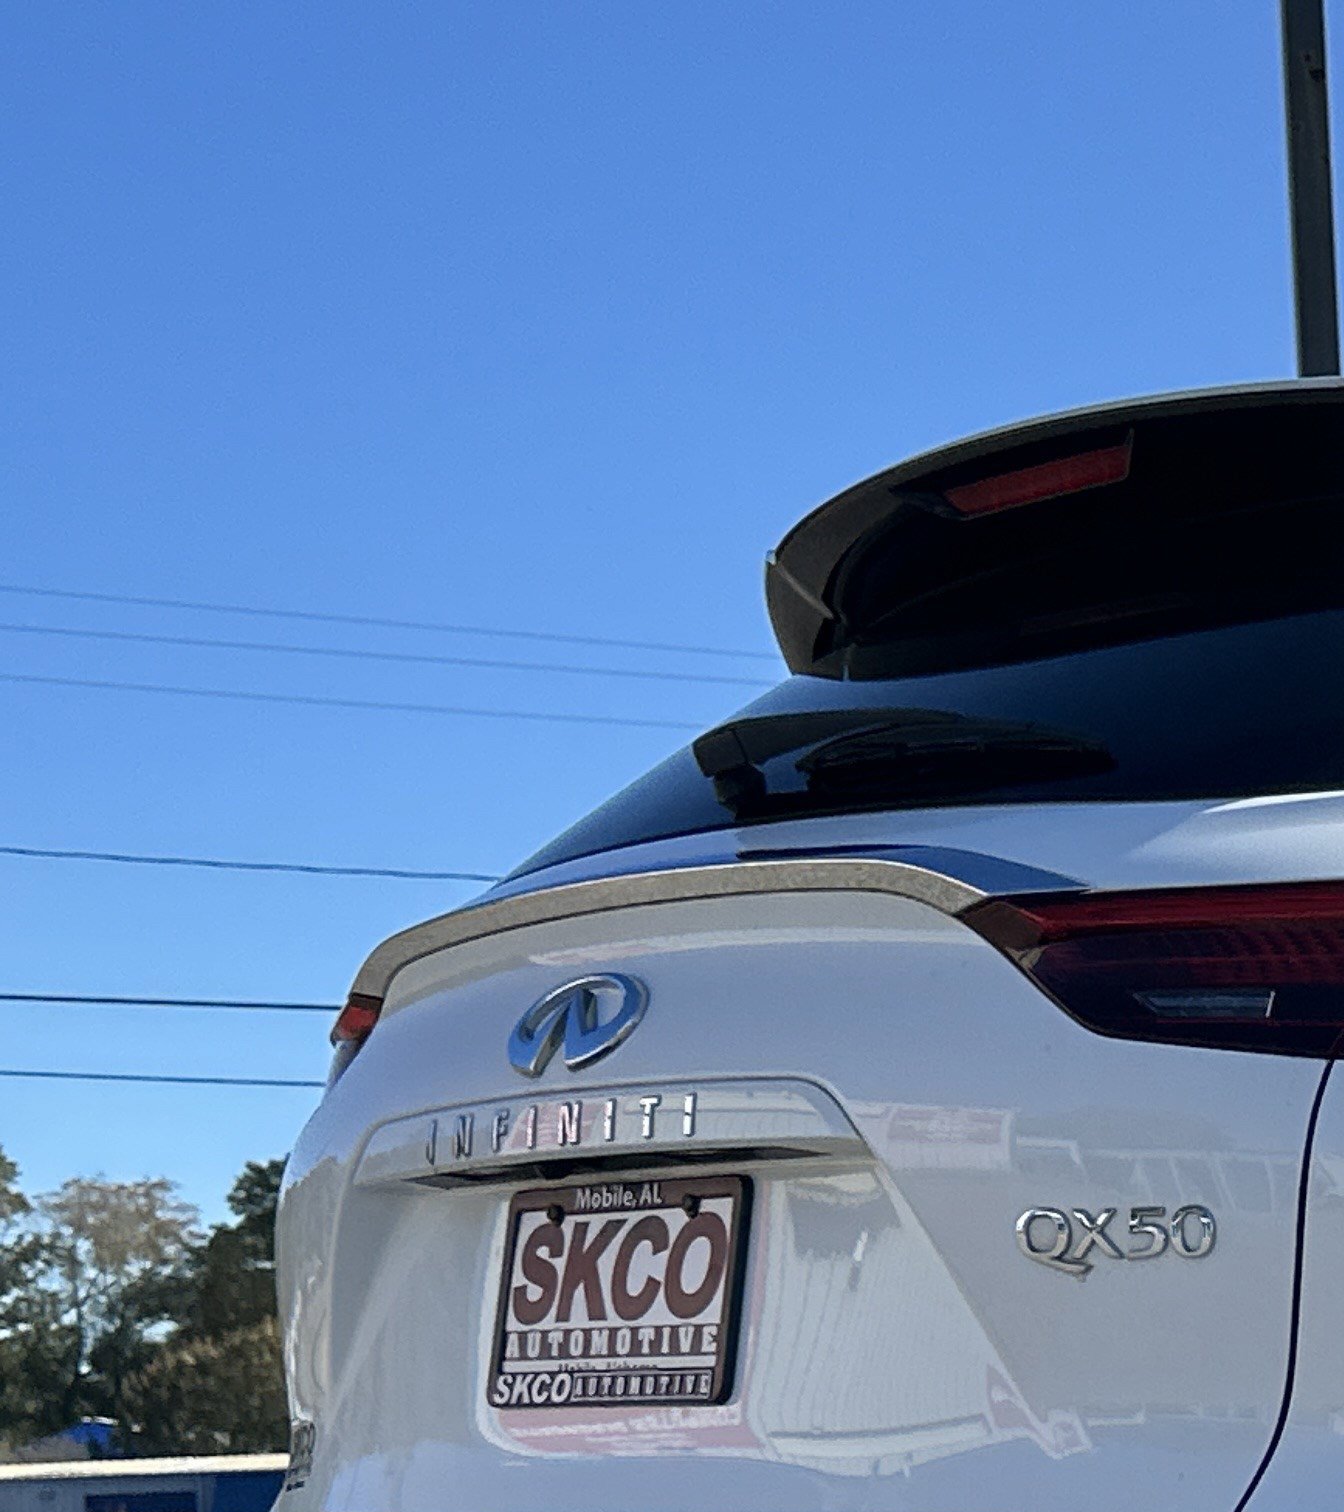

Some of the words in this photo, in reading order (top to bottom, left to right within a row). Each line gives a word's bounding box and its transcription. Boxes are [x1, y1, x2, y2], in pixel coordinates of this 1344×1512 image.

[425, 1091, 698, 1165] INFINITI
[575, 1183, 637, 1210] Mobile,
[638, 1182, 663, 1205] AL
[1015, 1204, 1217, 1275] QX50
[512, 1210, 728, 1326] SKCO
[504, 1325, 718, 1358] AUTOMOTIVE
[492, 1372, 573, 1405] SKCO
[574, 1374, 712, 1398] AUTOMOTIVE
